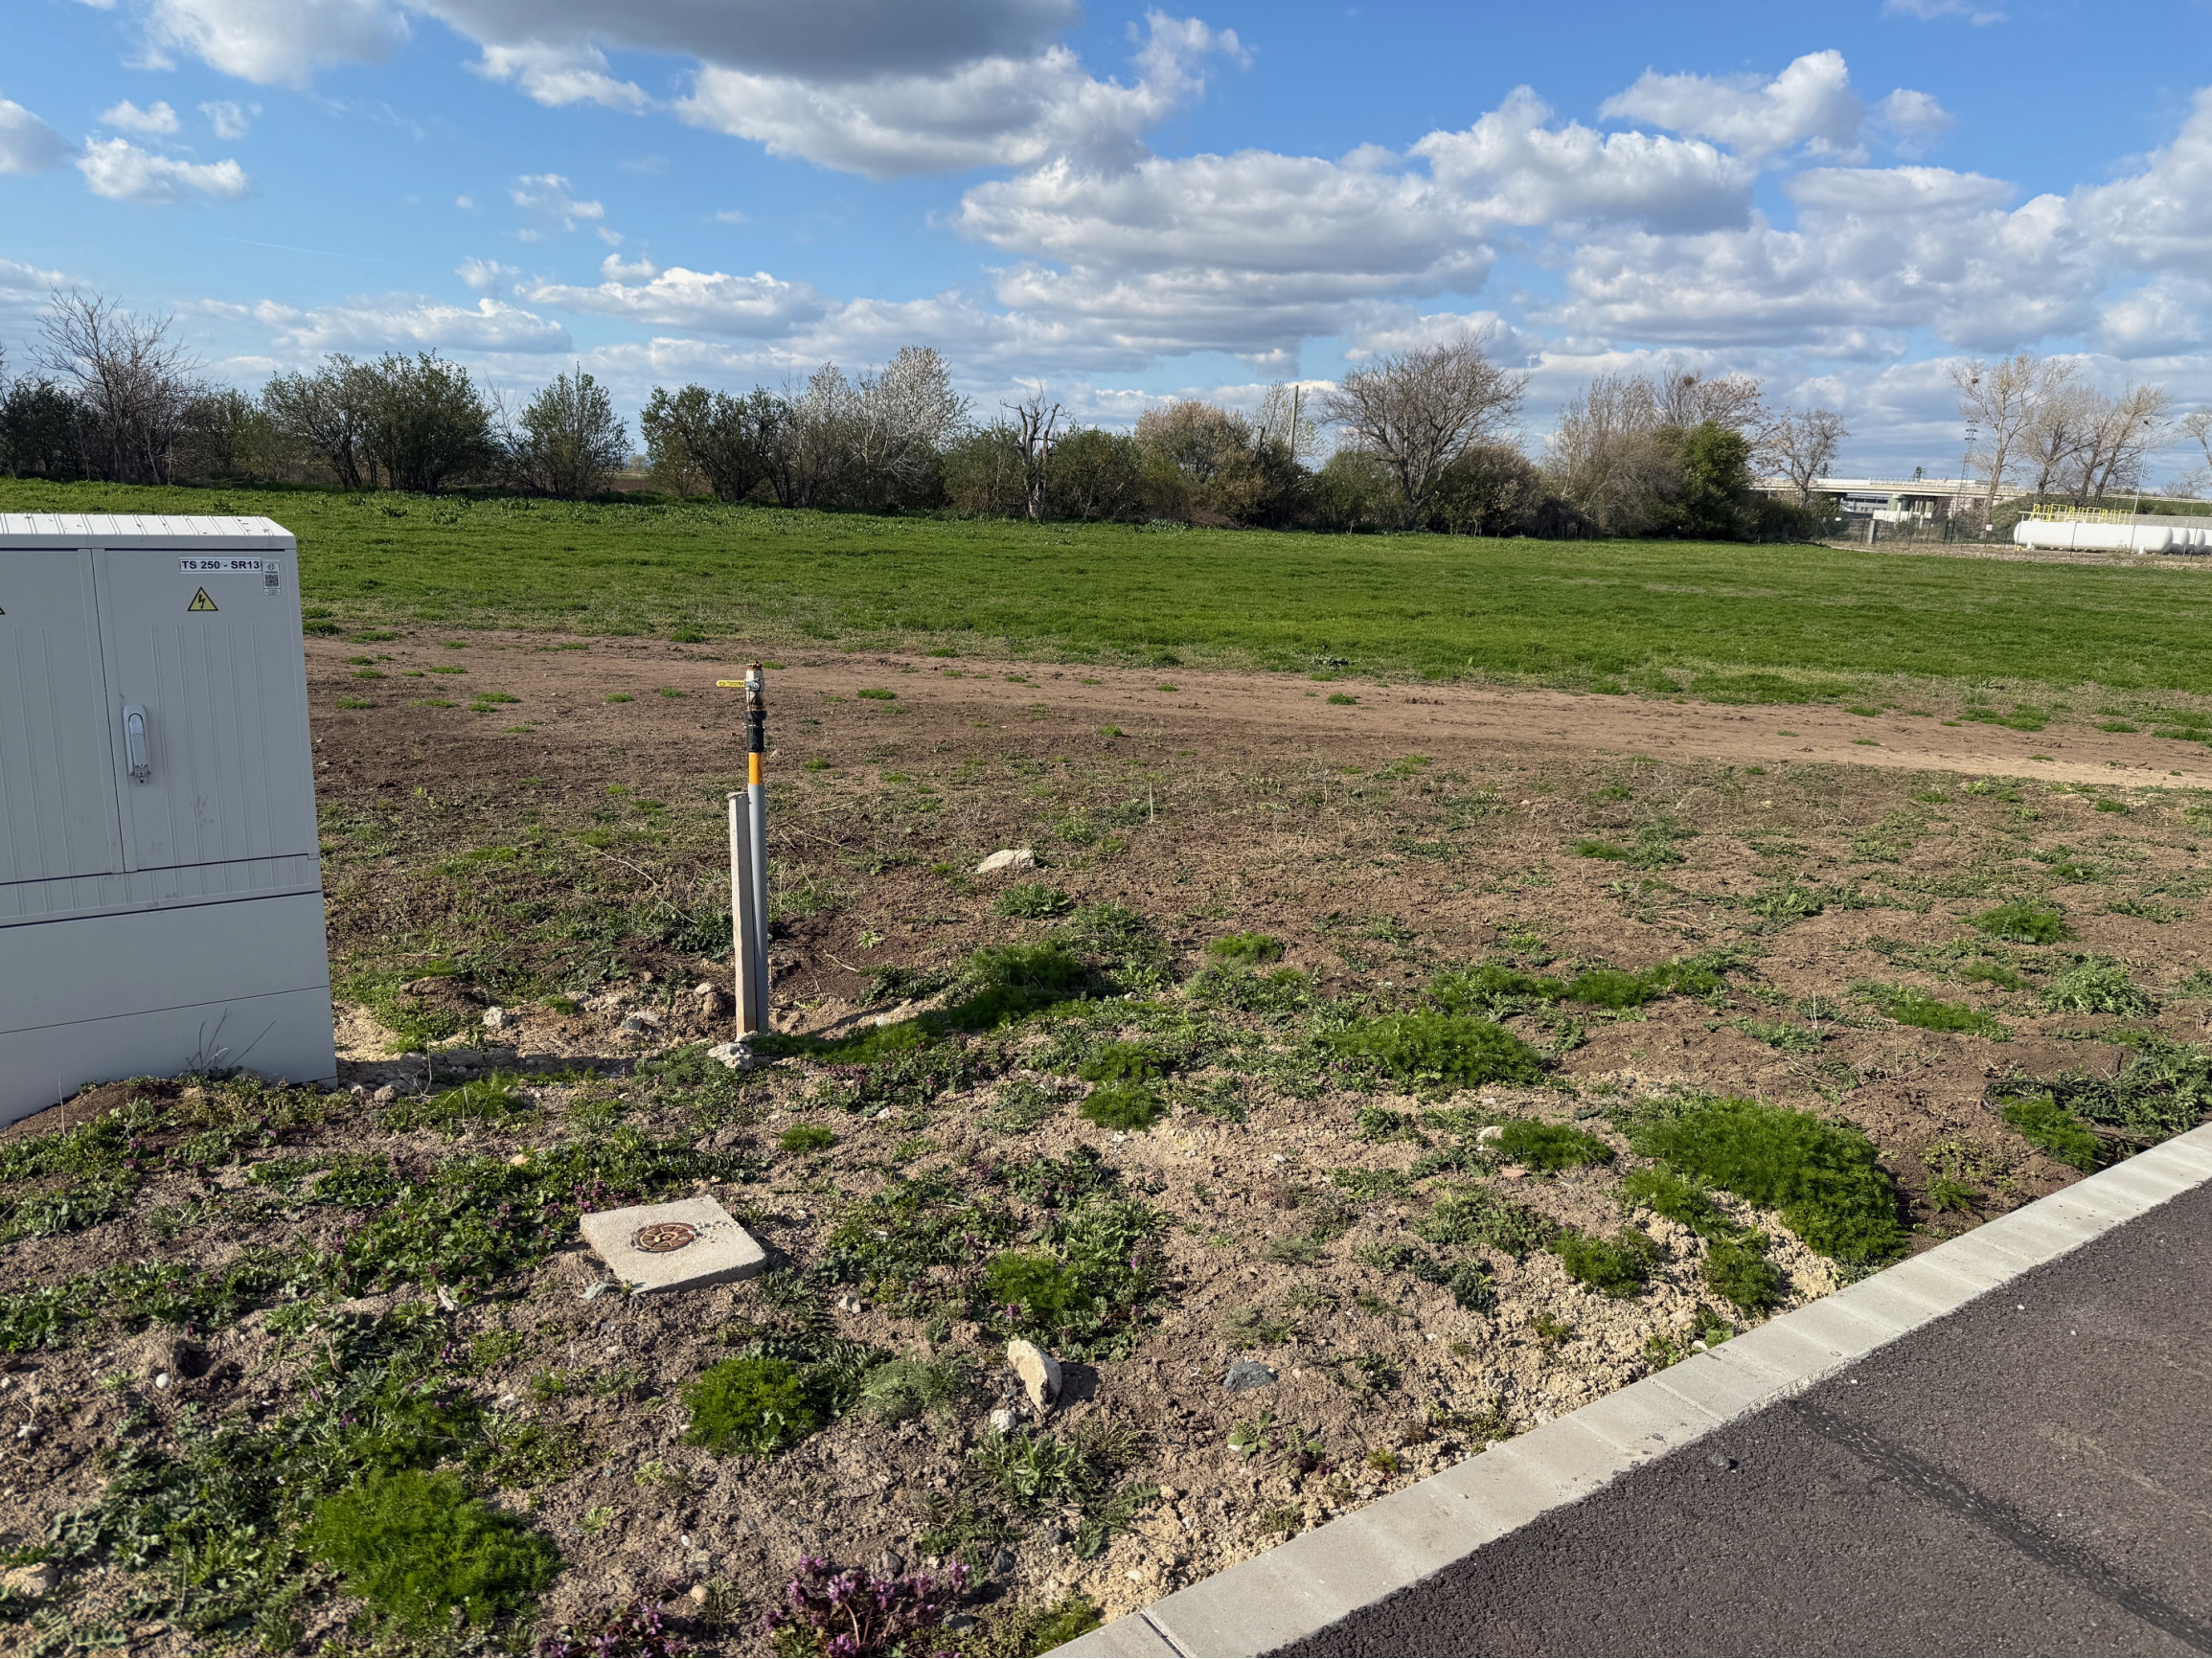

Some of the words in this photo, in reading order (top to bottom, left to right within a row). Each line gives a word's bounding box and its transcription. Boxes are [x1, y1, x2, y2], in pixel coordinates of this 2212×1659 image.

[181, 560, 197, 569] TS
[200, 560, 220, 569] 250
[231, 560, 260, 569] SR13
